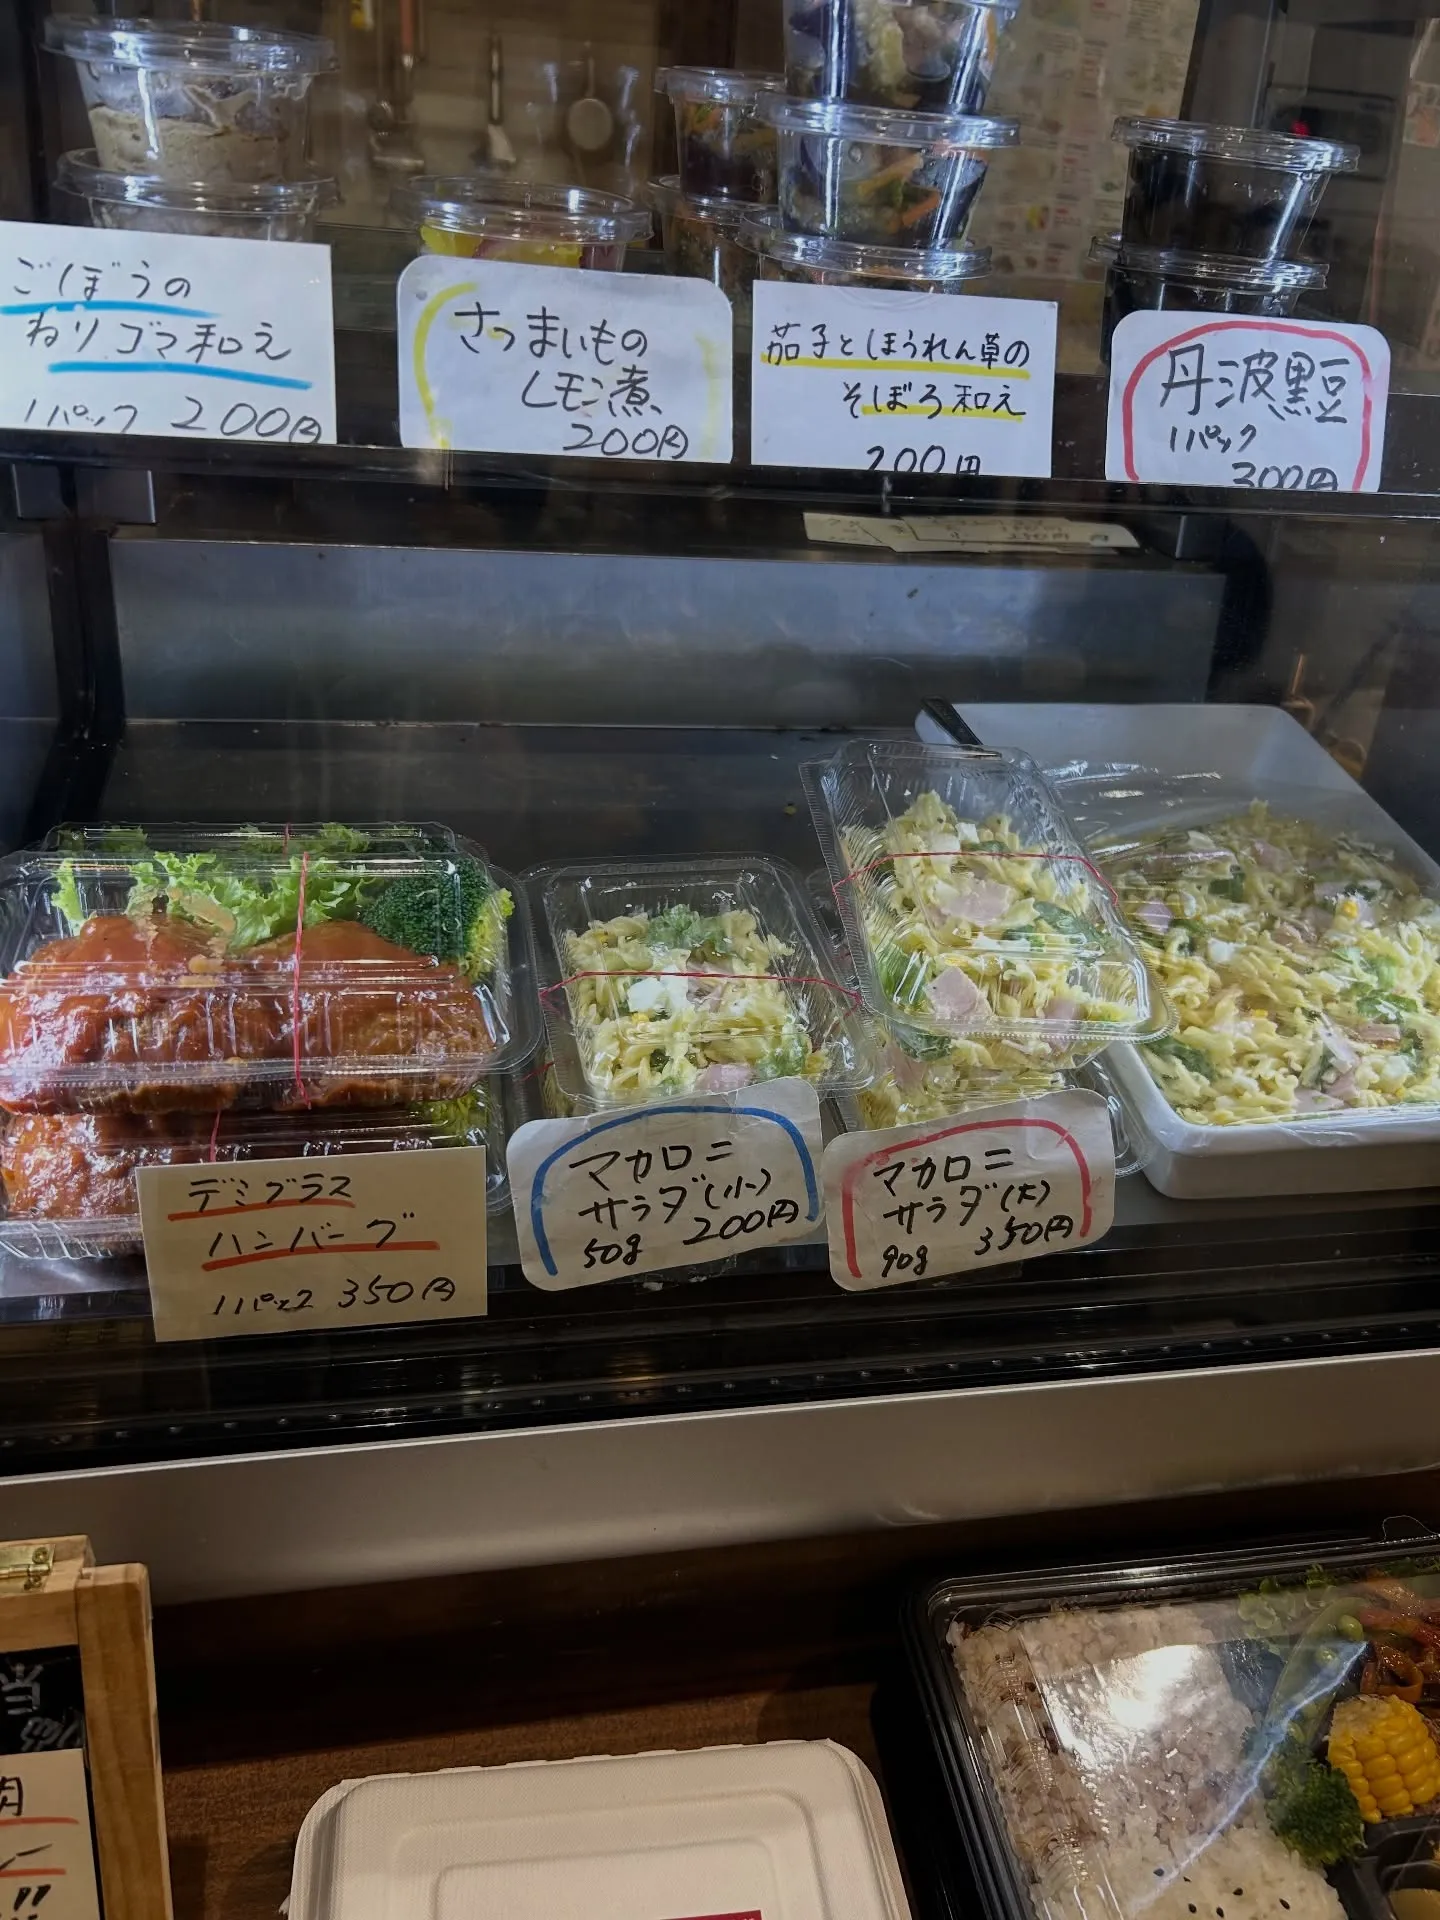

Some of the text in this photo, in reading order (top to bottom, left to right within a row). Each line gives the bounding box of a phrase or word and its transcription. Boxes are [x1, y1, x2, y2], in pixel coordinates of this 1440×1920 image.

[14, 257, 191, 300] ごぼうの
[26, 312, 291, 363] ねりゴマ和え
[454, 302, 648, 366] さつまいもの
[766, 322, 1031, 370] 茄子とほうれん草の
[522, 364, 662, 418] レモン煮
[843, 382, 1027, 419] そぼろ和え
[1160, 343, 1350, 423] 丹波黒豆
[171, 396, 322, 444] 200円
[563, 423, 689, 459] 200円
[1232, 462, 1339, 491] 300円
[569, 1141, 733, 1191] マカロニ
[873, 1148, 1014, 1196] マカロニ
[188, 1173, 352, 1213] デミグラス
[209, 1211, 415, 1257] ハンバーグ
[584, 1199, 799, 1268] 50g 200円
[881, 1214, 1074, 1278] 90g 350円
[338, 1274, 456, 1308] 350円
